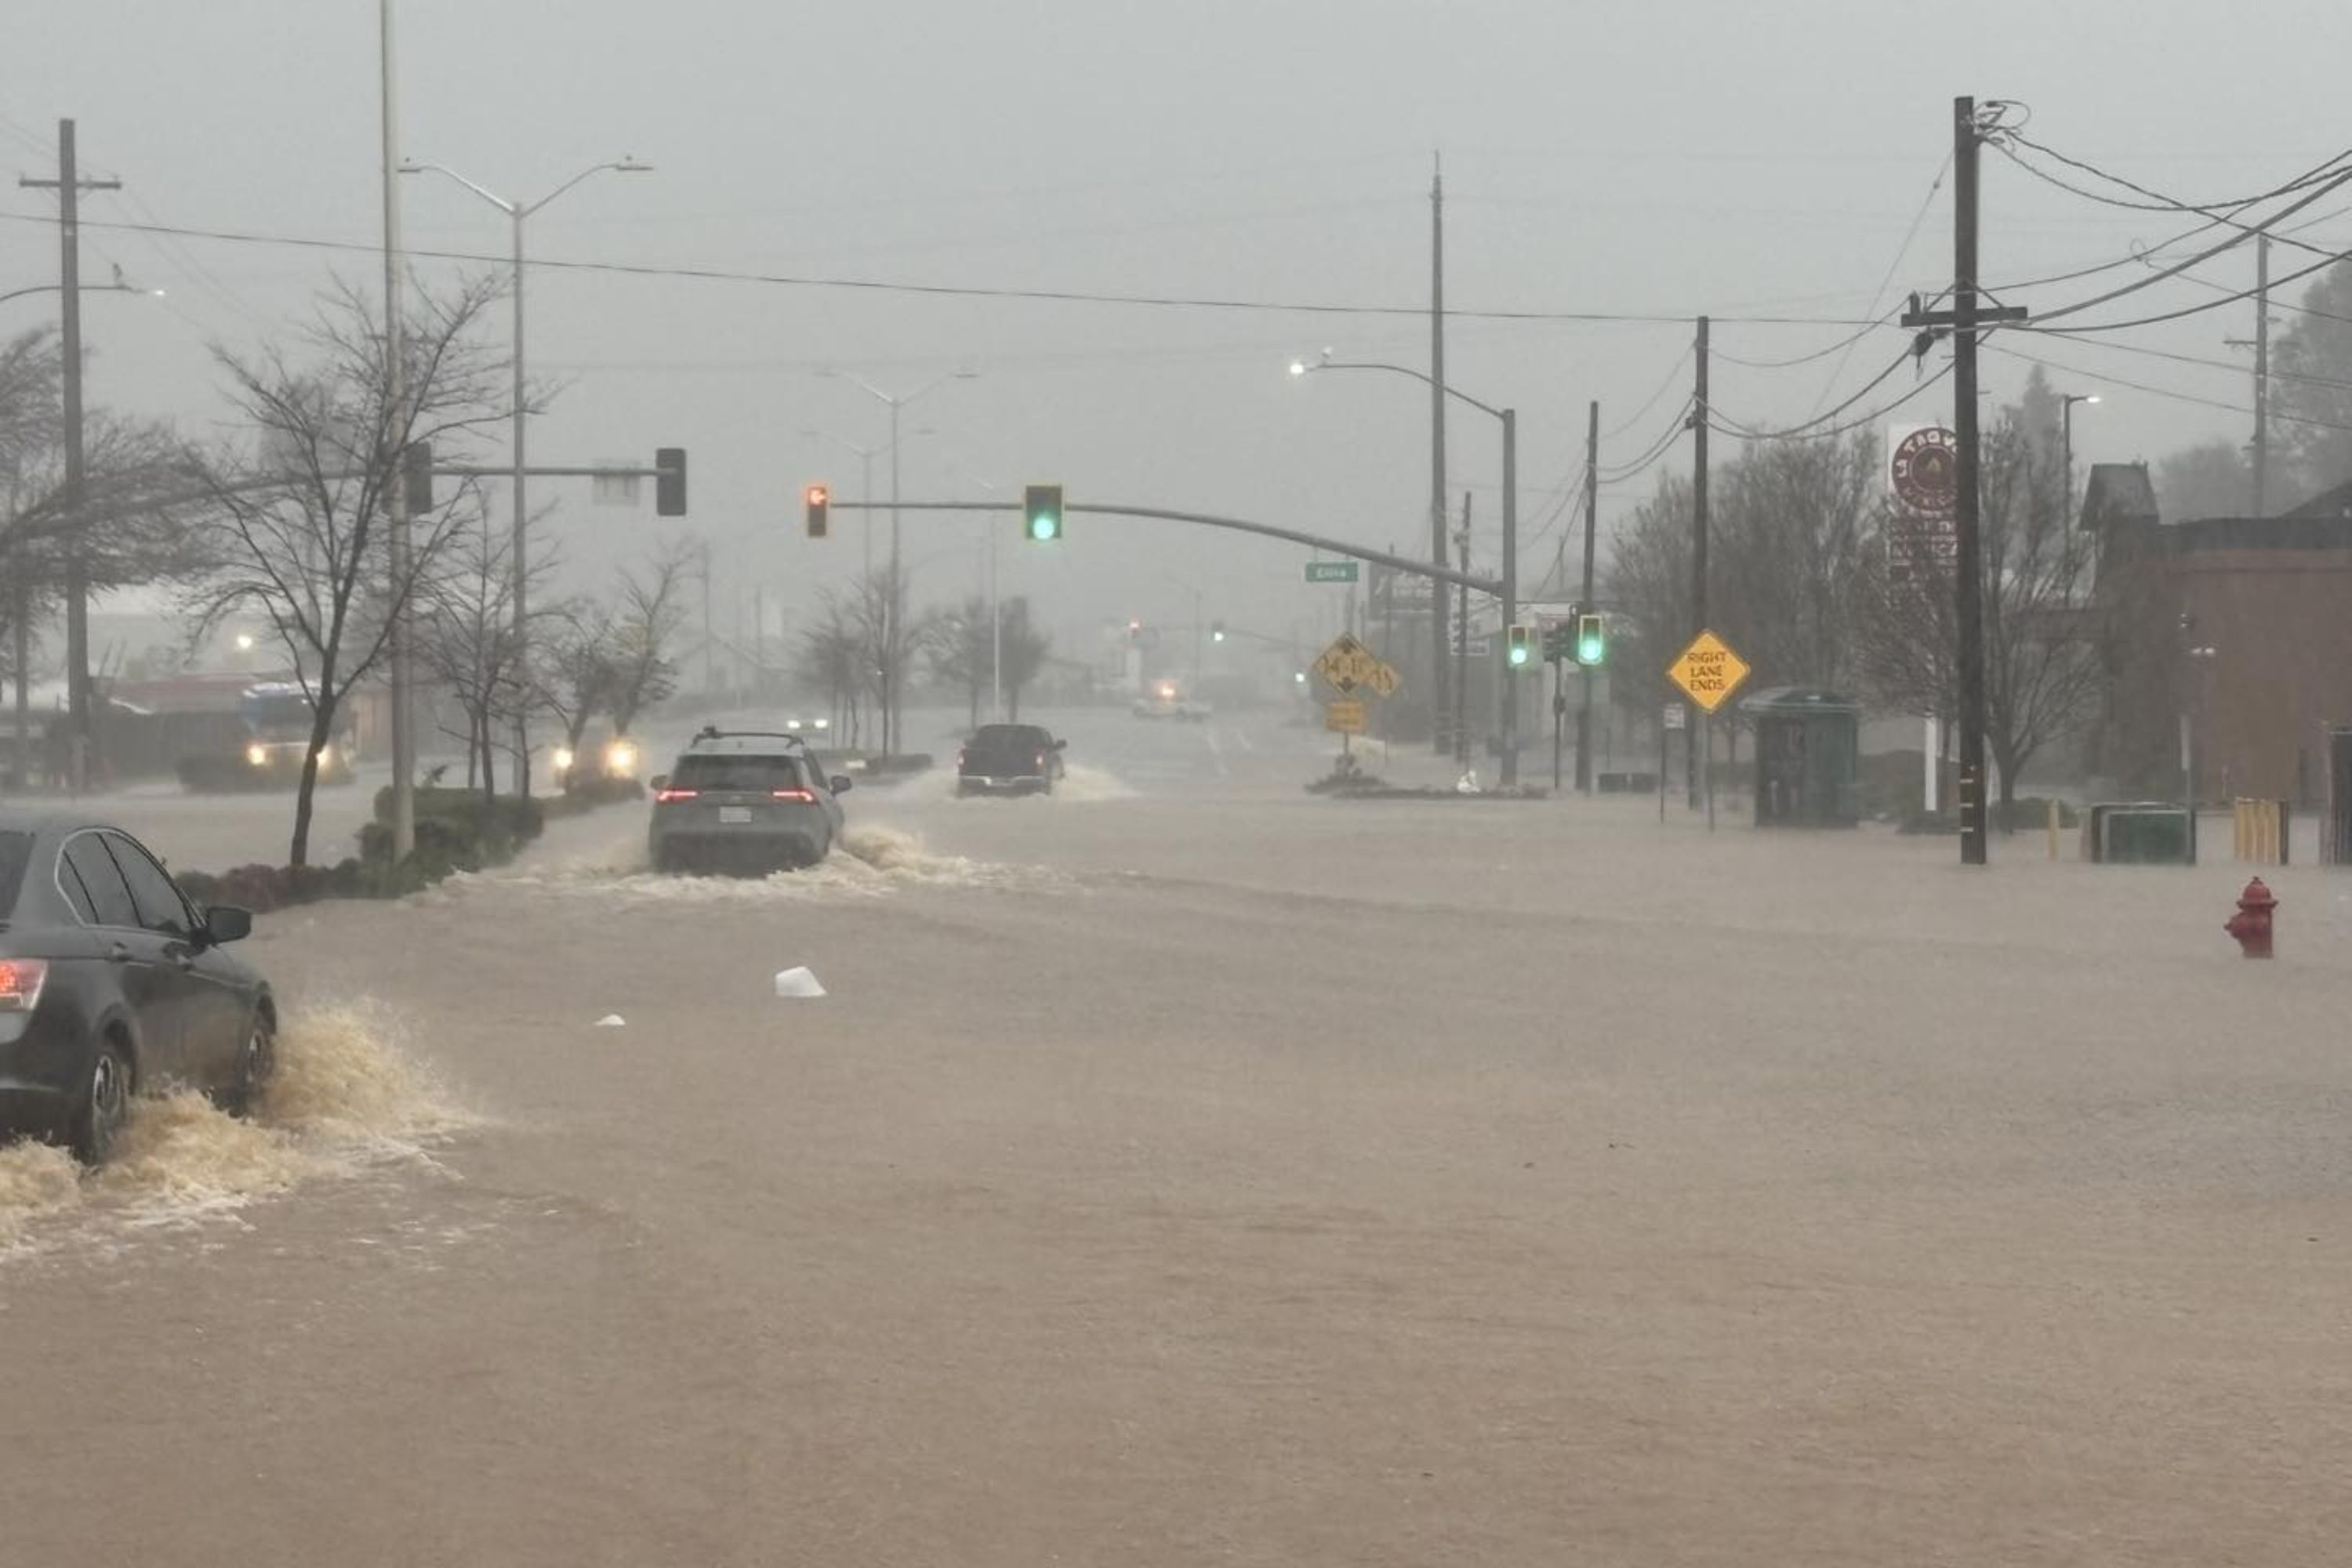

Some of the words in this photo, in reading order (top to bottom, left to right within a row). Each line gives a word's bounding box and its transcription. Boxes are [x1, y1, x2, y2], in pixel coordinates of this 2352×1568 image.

[1686, 652, 1726, 663] RIGHT
[1690, 665, 1722, 678] LANE
[1690, 679, 1725, 691] ENDS
